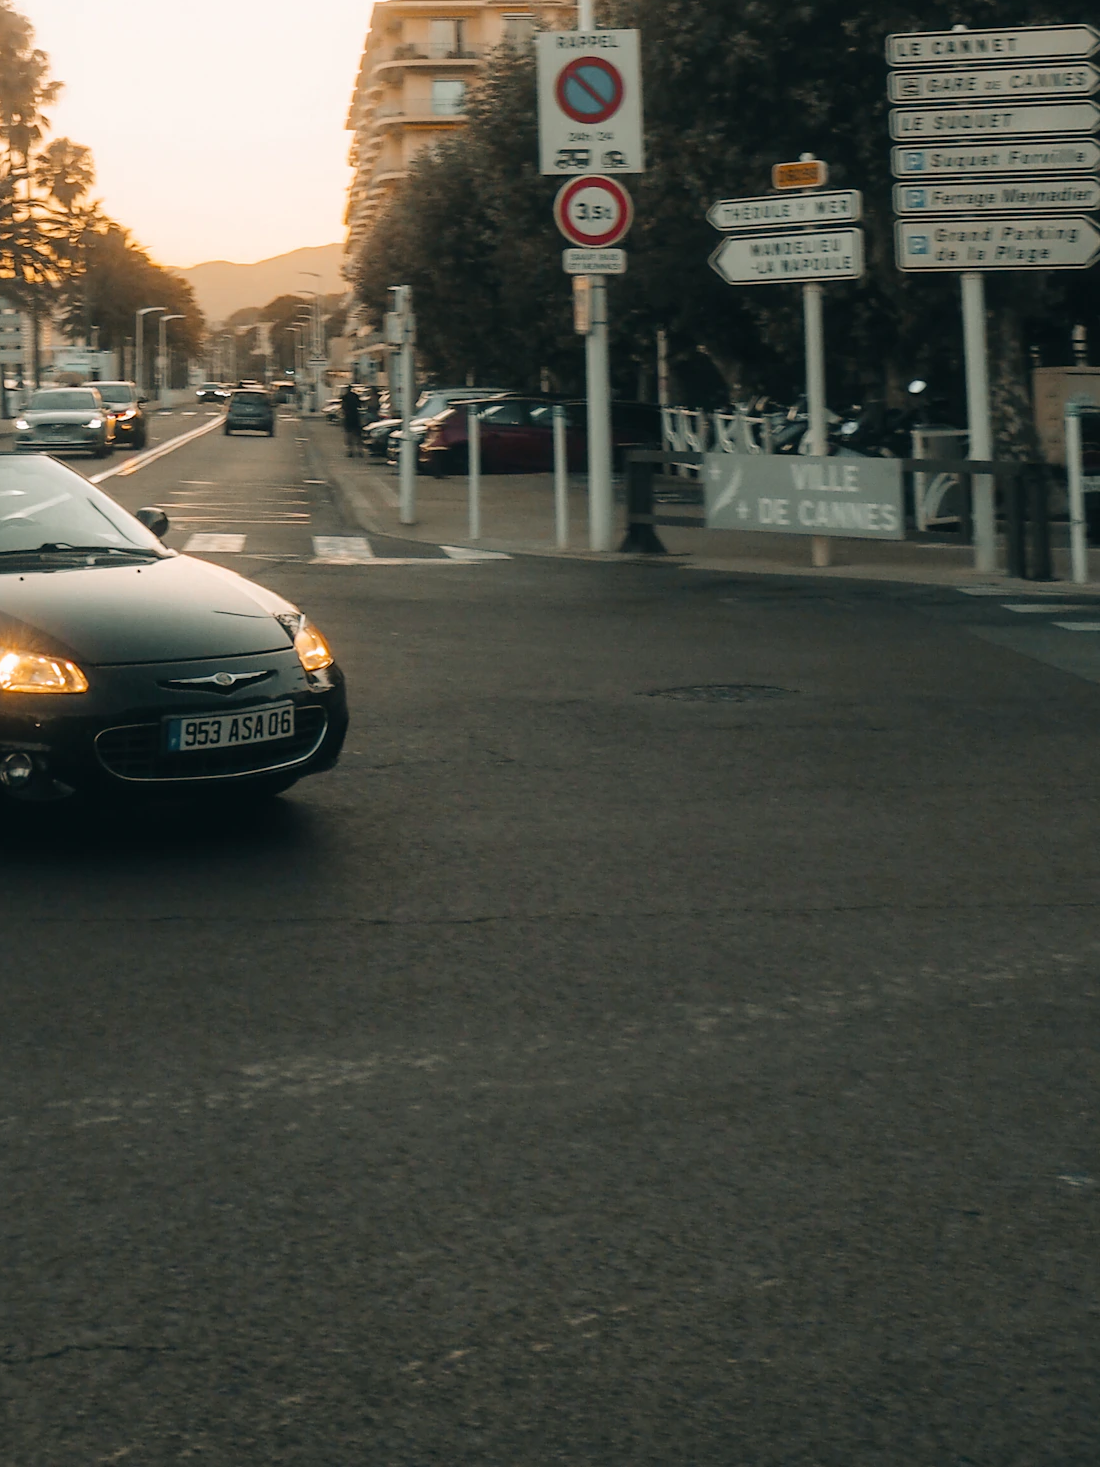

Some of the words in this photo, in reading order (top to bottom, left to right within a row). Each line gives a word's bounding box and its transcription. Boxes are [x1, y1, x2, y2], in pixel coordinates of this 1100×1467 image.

[556, 34, 620, 49] RAPPEL
[897, 41, 922, 57] LE
[931, 37, 1018, 55] CANNET
[926, 76, 978, 93] GARE
[1008, 72, 1088, 90] CANNES
[901, 116, 924, 132] LE
[933, 113, 1013, 130] SUQUET
[930, 153, 1000, 171] Suquet
[934, 228, 993, 243] Grand
[1001, 225, 1080, 243] Parking
[750, 238, 841, 257] MANDELIEU
[995, 245, 1050, 263] Plage
[790, 463, 860, 492] VILLE
[758, 497, 790, 526] DE
[797, 498, 898, 531] CANNES
[185, 720, 222, 747] 953
[228, 714, 264, 743] ASA
[268, 710, 291, 737] 06
